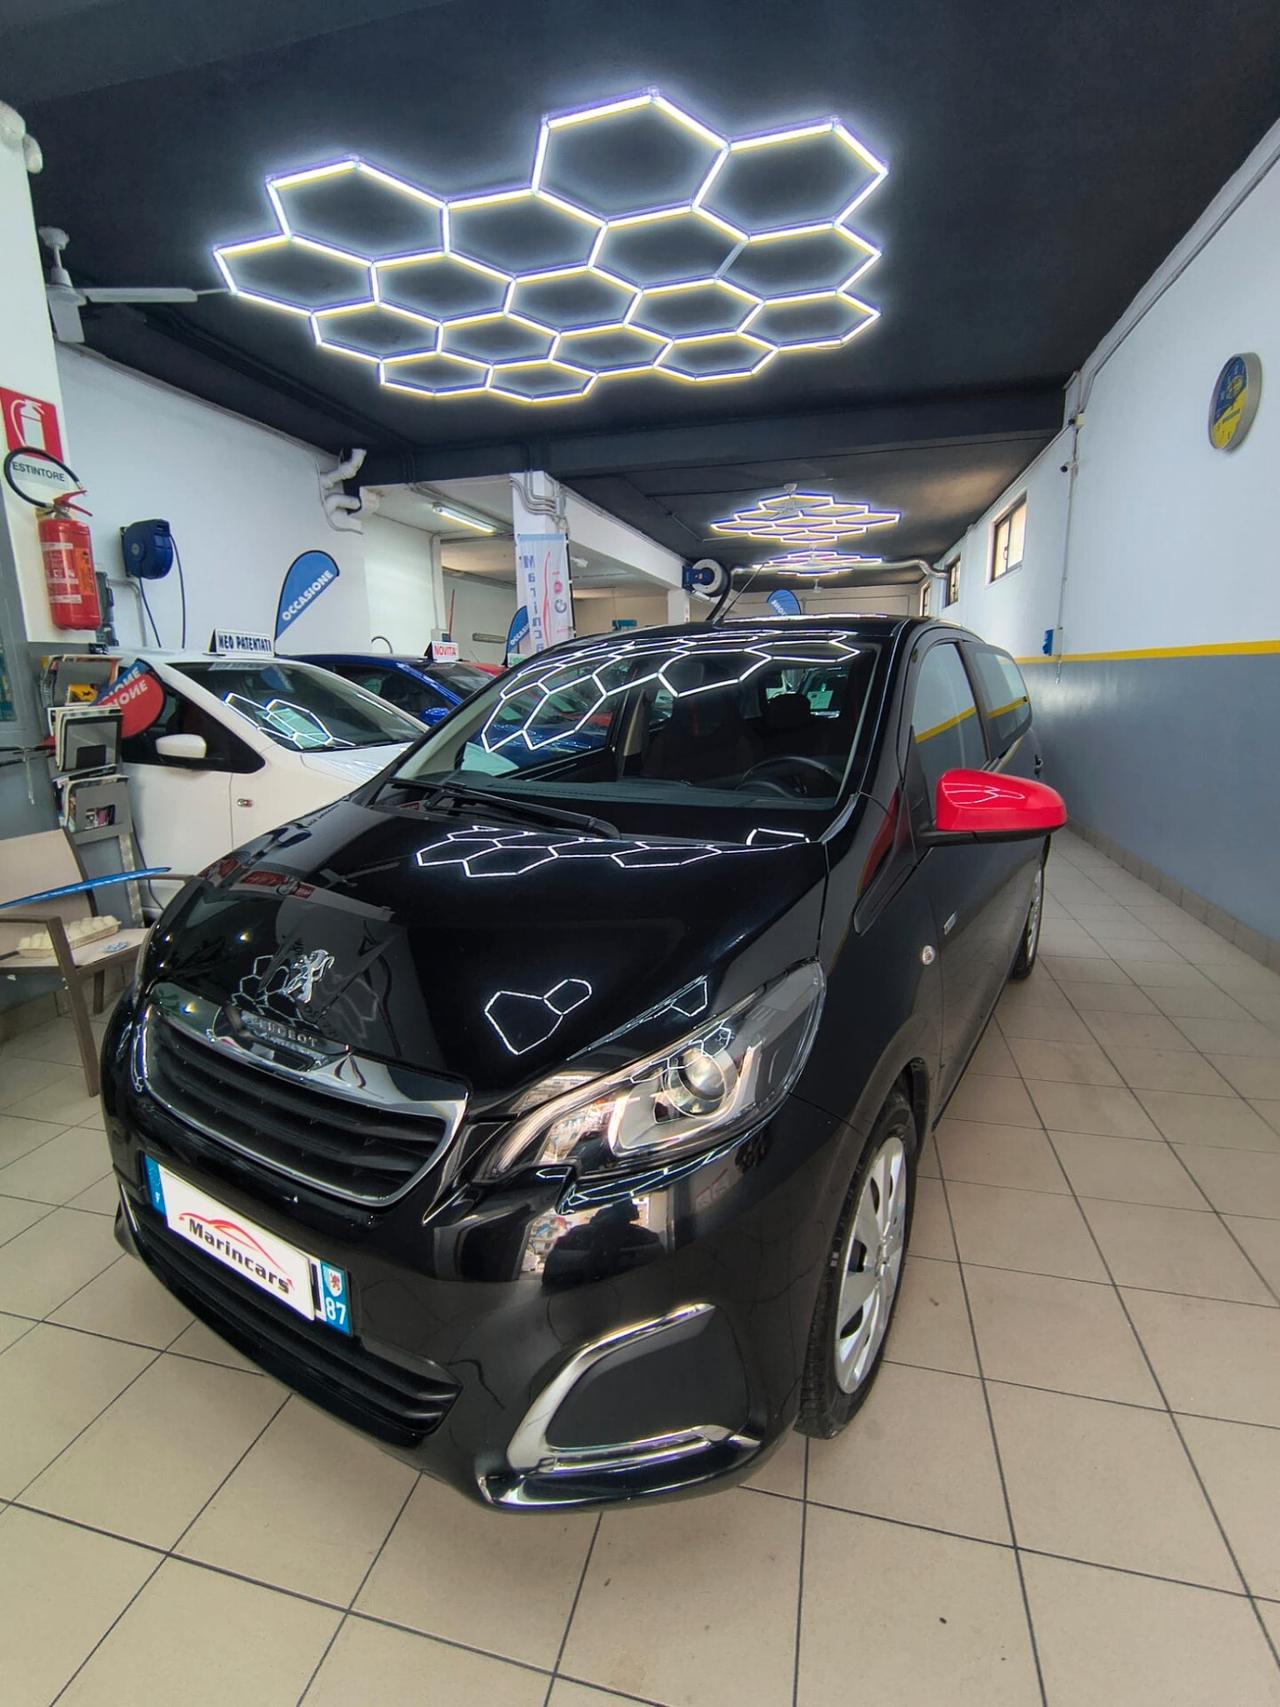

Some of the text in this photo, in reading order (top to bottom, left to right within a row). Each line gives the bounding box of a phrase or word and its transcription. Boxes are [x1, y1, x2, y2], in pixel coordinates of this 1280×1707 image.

[12, 461, 65, 482] ESTINTORE
[282, 569, 334, 621] OCCASIONE
[218, 635, 272, 652] NEO PATENTATI
[189, 1218, 289, 1294] Marincars
[325, 1296, 346, 1325] 87
